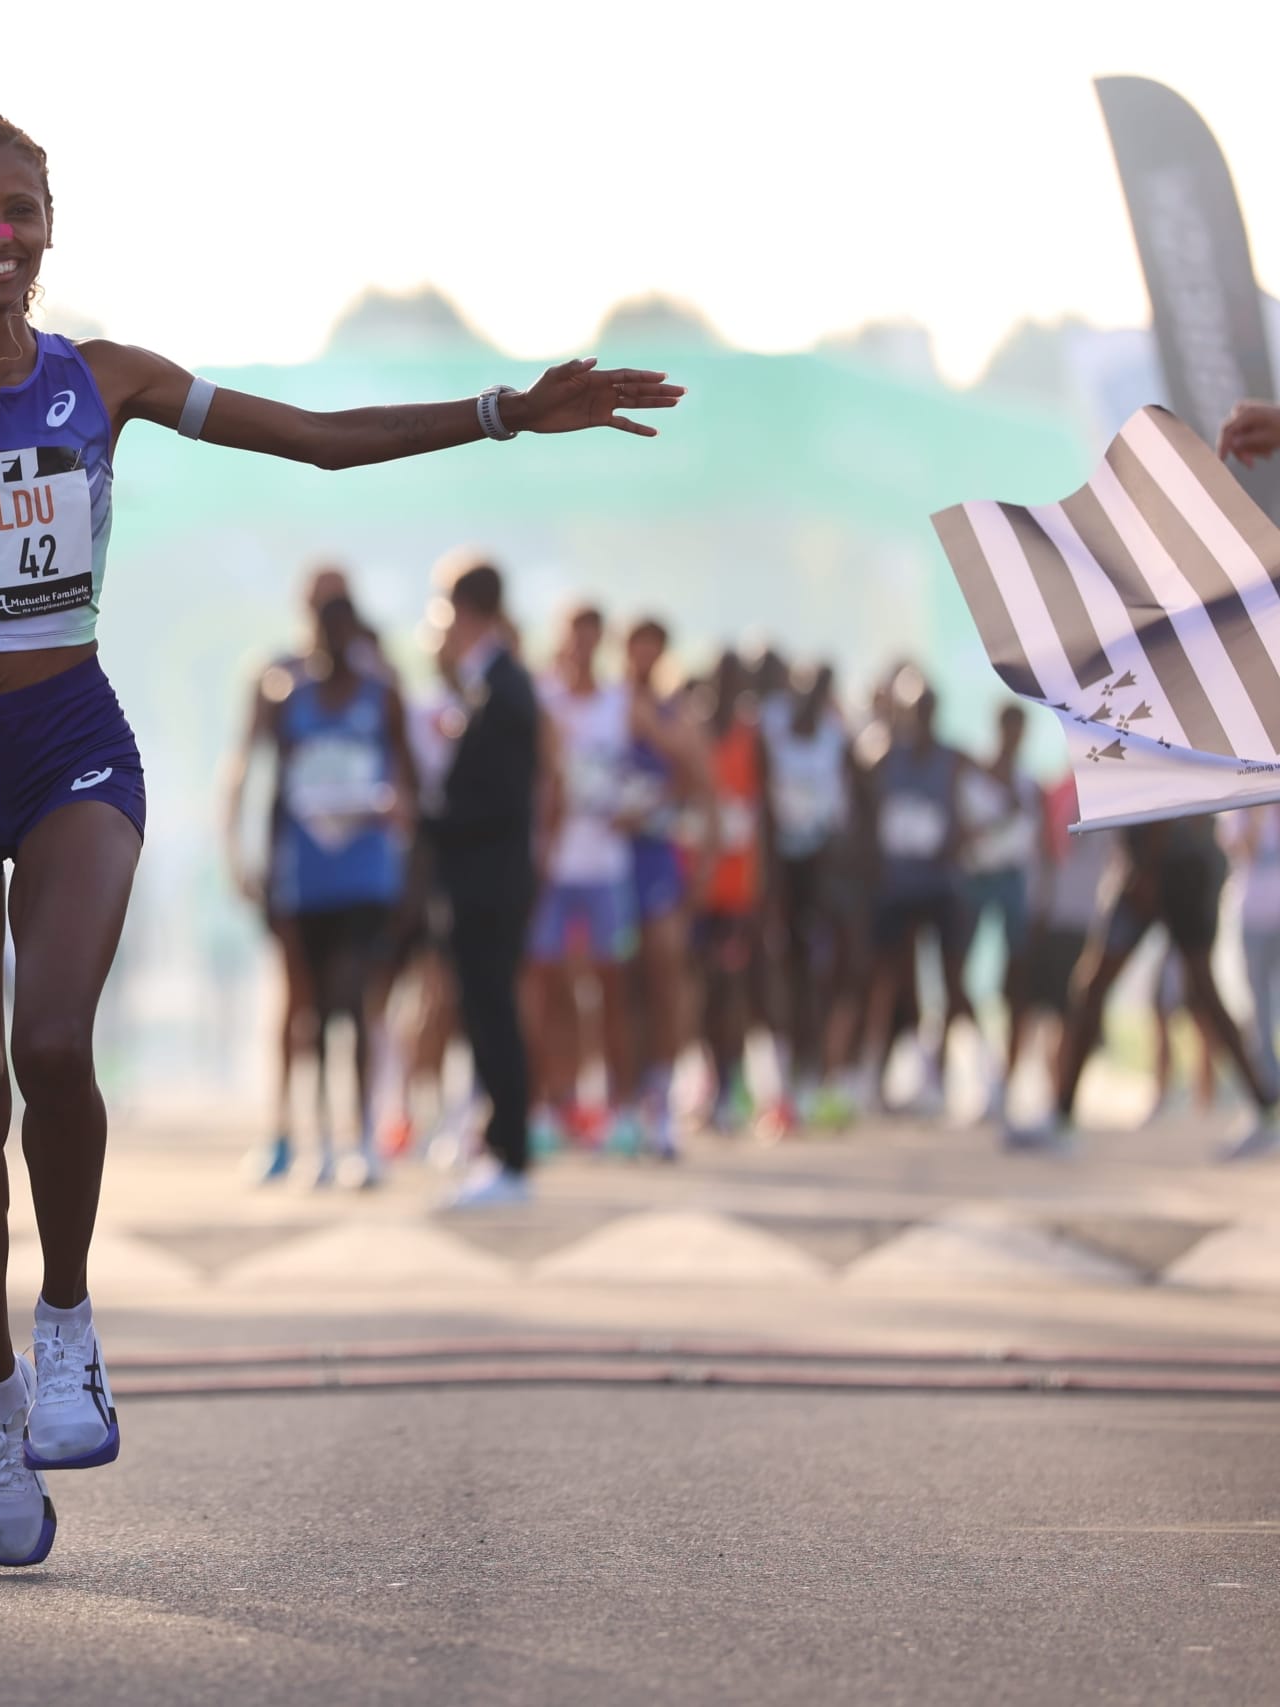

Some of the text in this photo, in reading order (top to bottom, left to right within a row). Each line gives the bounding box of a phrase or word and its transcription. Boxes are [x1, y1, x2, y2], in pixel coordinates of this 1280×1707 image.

[19, 534, 59, 578] 42
[11, 593, 51, 607] Mutuelle
[52, 585, 89, 600] Familiale
